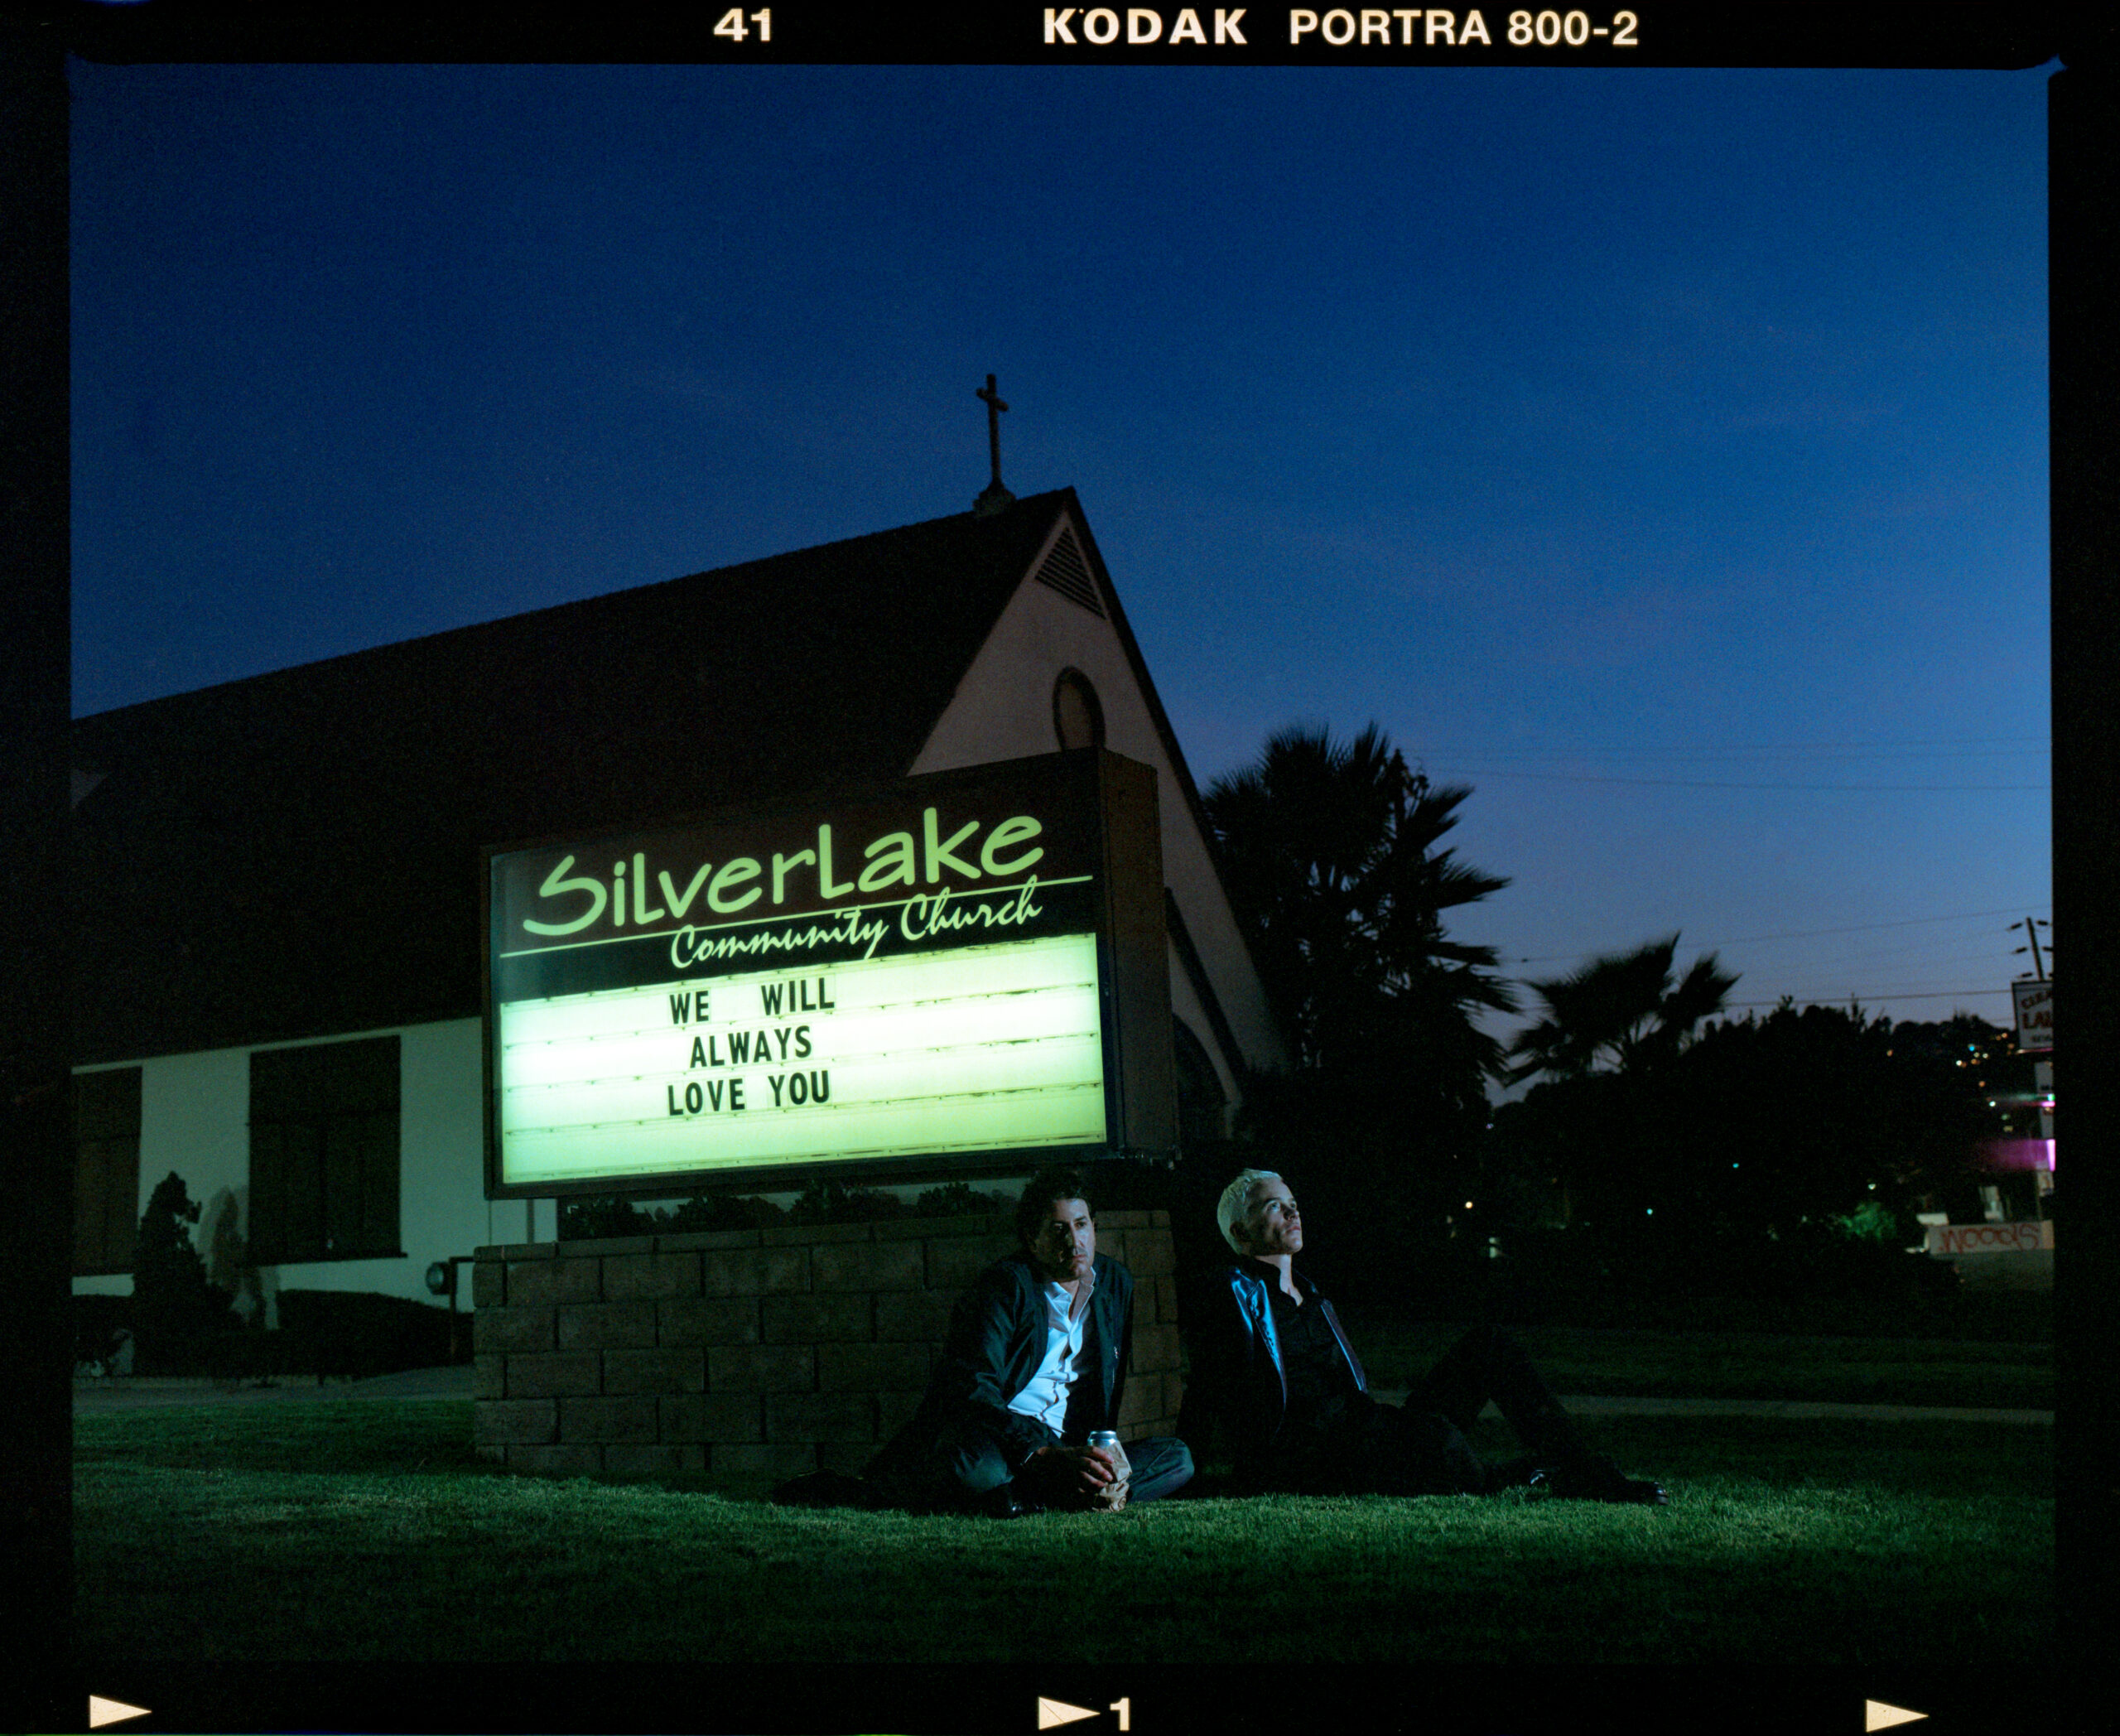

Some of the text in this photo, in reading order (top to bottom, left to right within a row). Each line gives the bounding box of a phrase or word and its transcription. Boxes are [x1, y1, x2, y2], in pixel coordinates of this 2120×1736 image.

[714, 8, 770, 41] 41
[1043, 7, 1638, 46] KODAK PORTRA 800-2
[671, 874, 1043, 968] Community Church
[669, 977, 835, 1025] WE WILL
[690, 1025, 812, 1068] ALWAYS
[667, 1070, 830, 1116] LOVE YOU
[1110, 1697, 1130, 1731] 1
